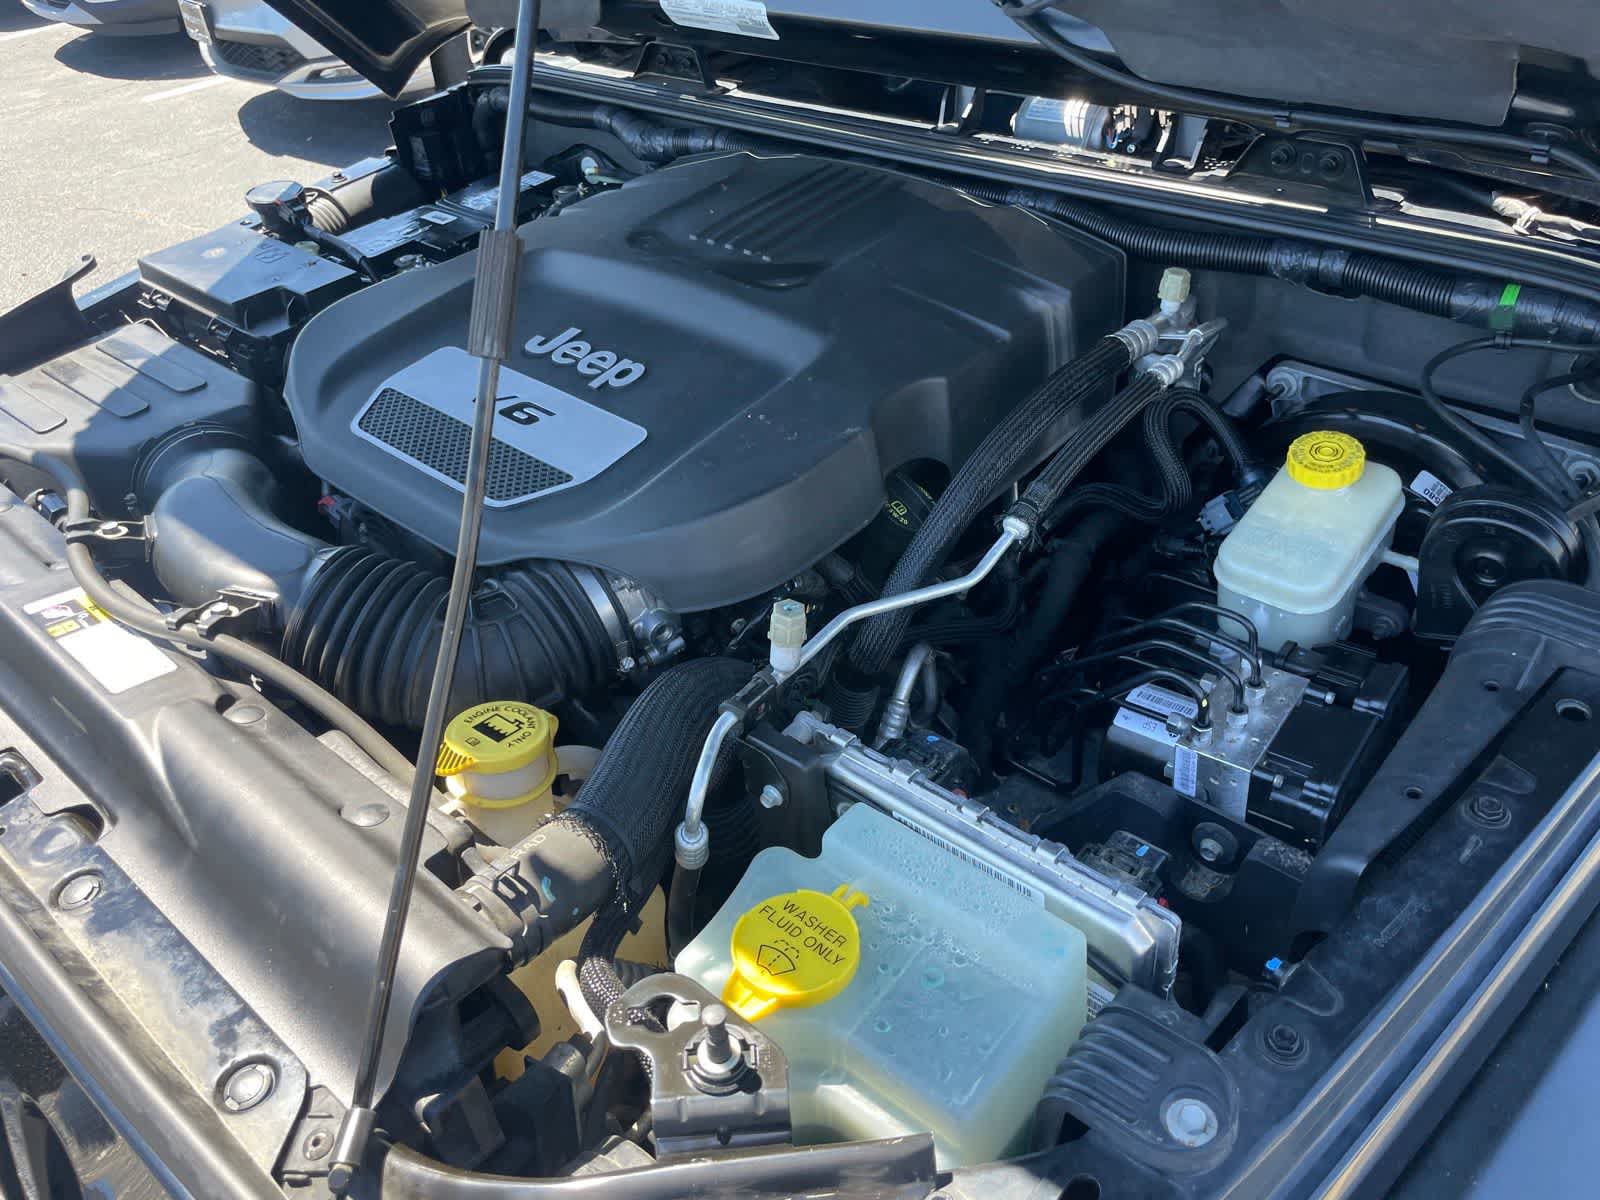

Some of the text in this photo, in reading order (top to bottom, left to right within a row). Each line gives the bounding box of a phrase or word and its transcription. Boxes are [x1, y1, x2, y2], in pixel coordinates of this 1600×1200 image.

[524, 327, 646, 389] Jeep
[463, 706, 536, 748] ENGINE COOLANT ONLY
[758, 905, 845, 965] FLUID ONLY
[784, 900, 847, 947] WASHER
